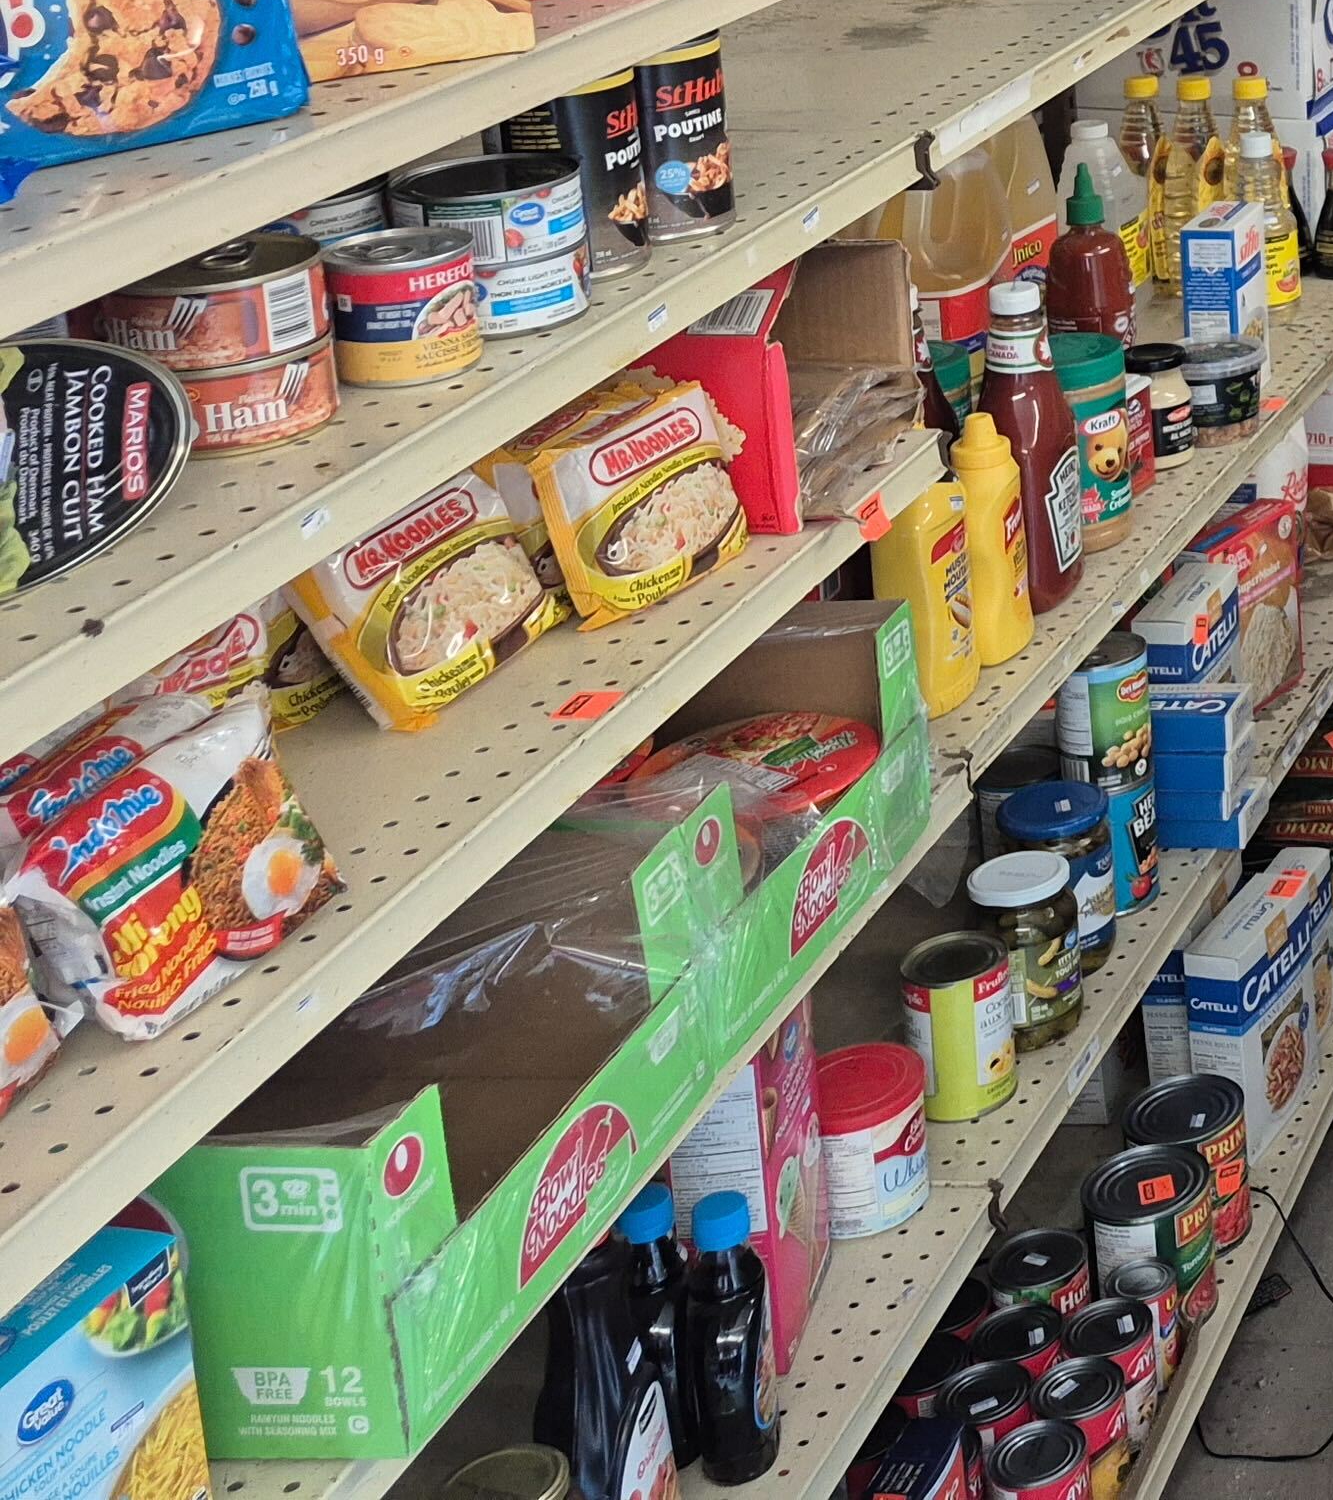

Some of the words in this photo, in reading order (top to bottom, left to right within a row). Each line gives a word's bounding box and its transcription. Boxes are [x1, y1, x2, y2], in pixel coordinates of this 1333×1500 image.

[337, 45, 368, 66] 350
[374, 48, 385, 68] g
[654, 107, 722, 142] POUTINE
[988, 349, 1018, 361] CANADA
[62, 368, 91, 475] JAMBON
[87, 365, 113, 463] COOKED
[205, 398, 289, 433] Ham
[1089, 412, 1117, 431] Kraft
[127, 388, 149, 494] MARIO'S
[62, 480, 84, 542] CUIT
[84, 473, 106, 533] HAM
[629, 573, 670, 594] Chicken
[51, 783, 163, 886] Indomie
[85, 874, 132, 911] Instant
[131, 839, 188, 885] Noodles
[1242, 928, 1311, 1012] CATELLI
[1190, 998, 1238, 1014] CATELLI
[532, 1137, 585, 1217] Bowl
[252, 1180, 279, 1218] 3
[280, 1202, 318, 1217] min
[526, 1147, 608, 1260] Noodles
[254, 1371, 291, 1387] BPA
[256, 1387, 293, 1400] FREE
[320, 1366, 363, 1393] 12
[325, 1396, 367, 1407] BOWLS
[55, 1407, 108, 1459] NOODLE
